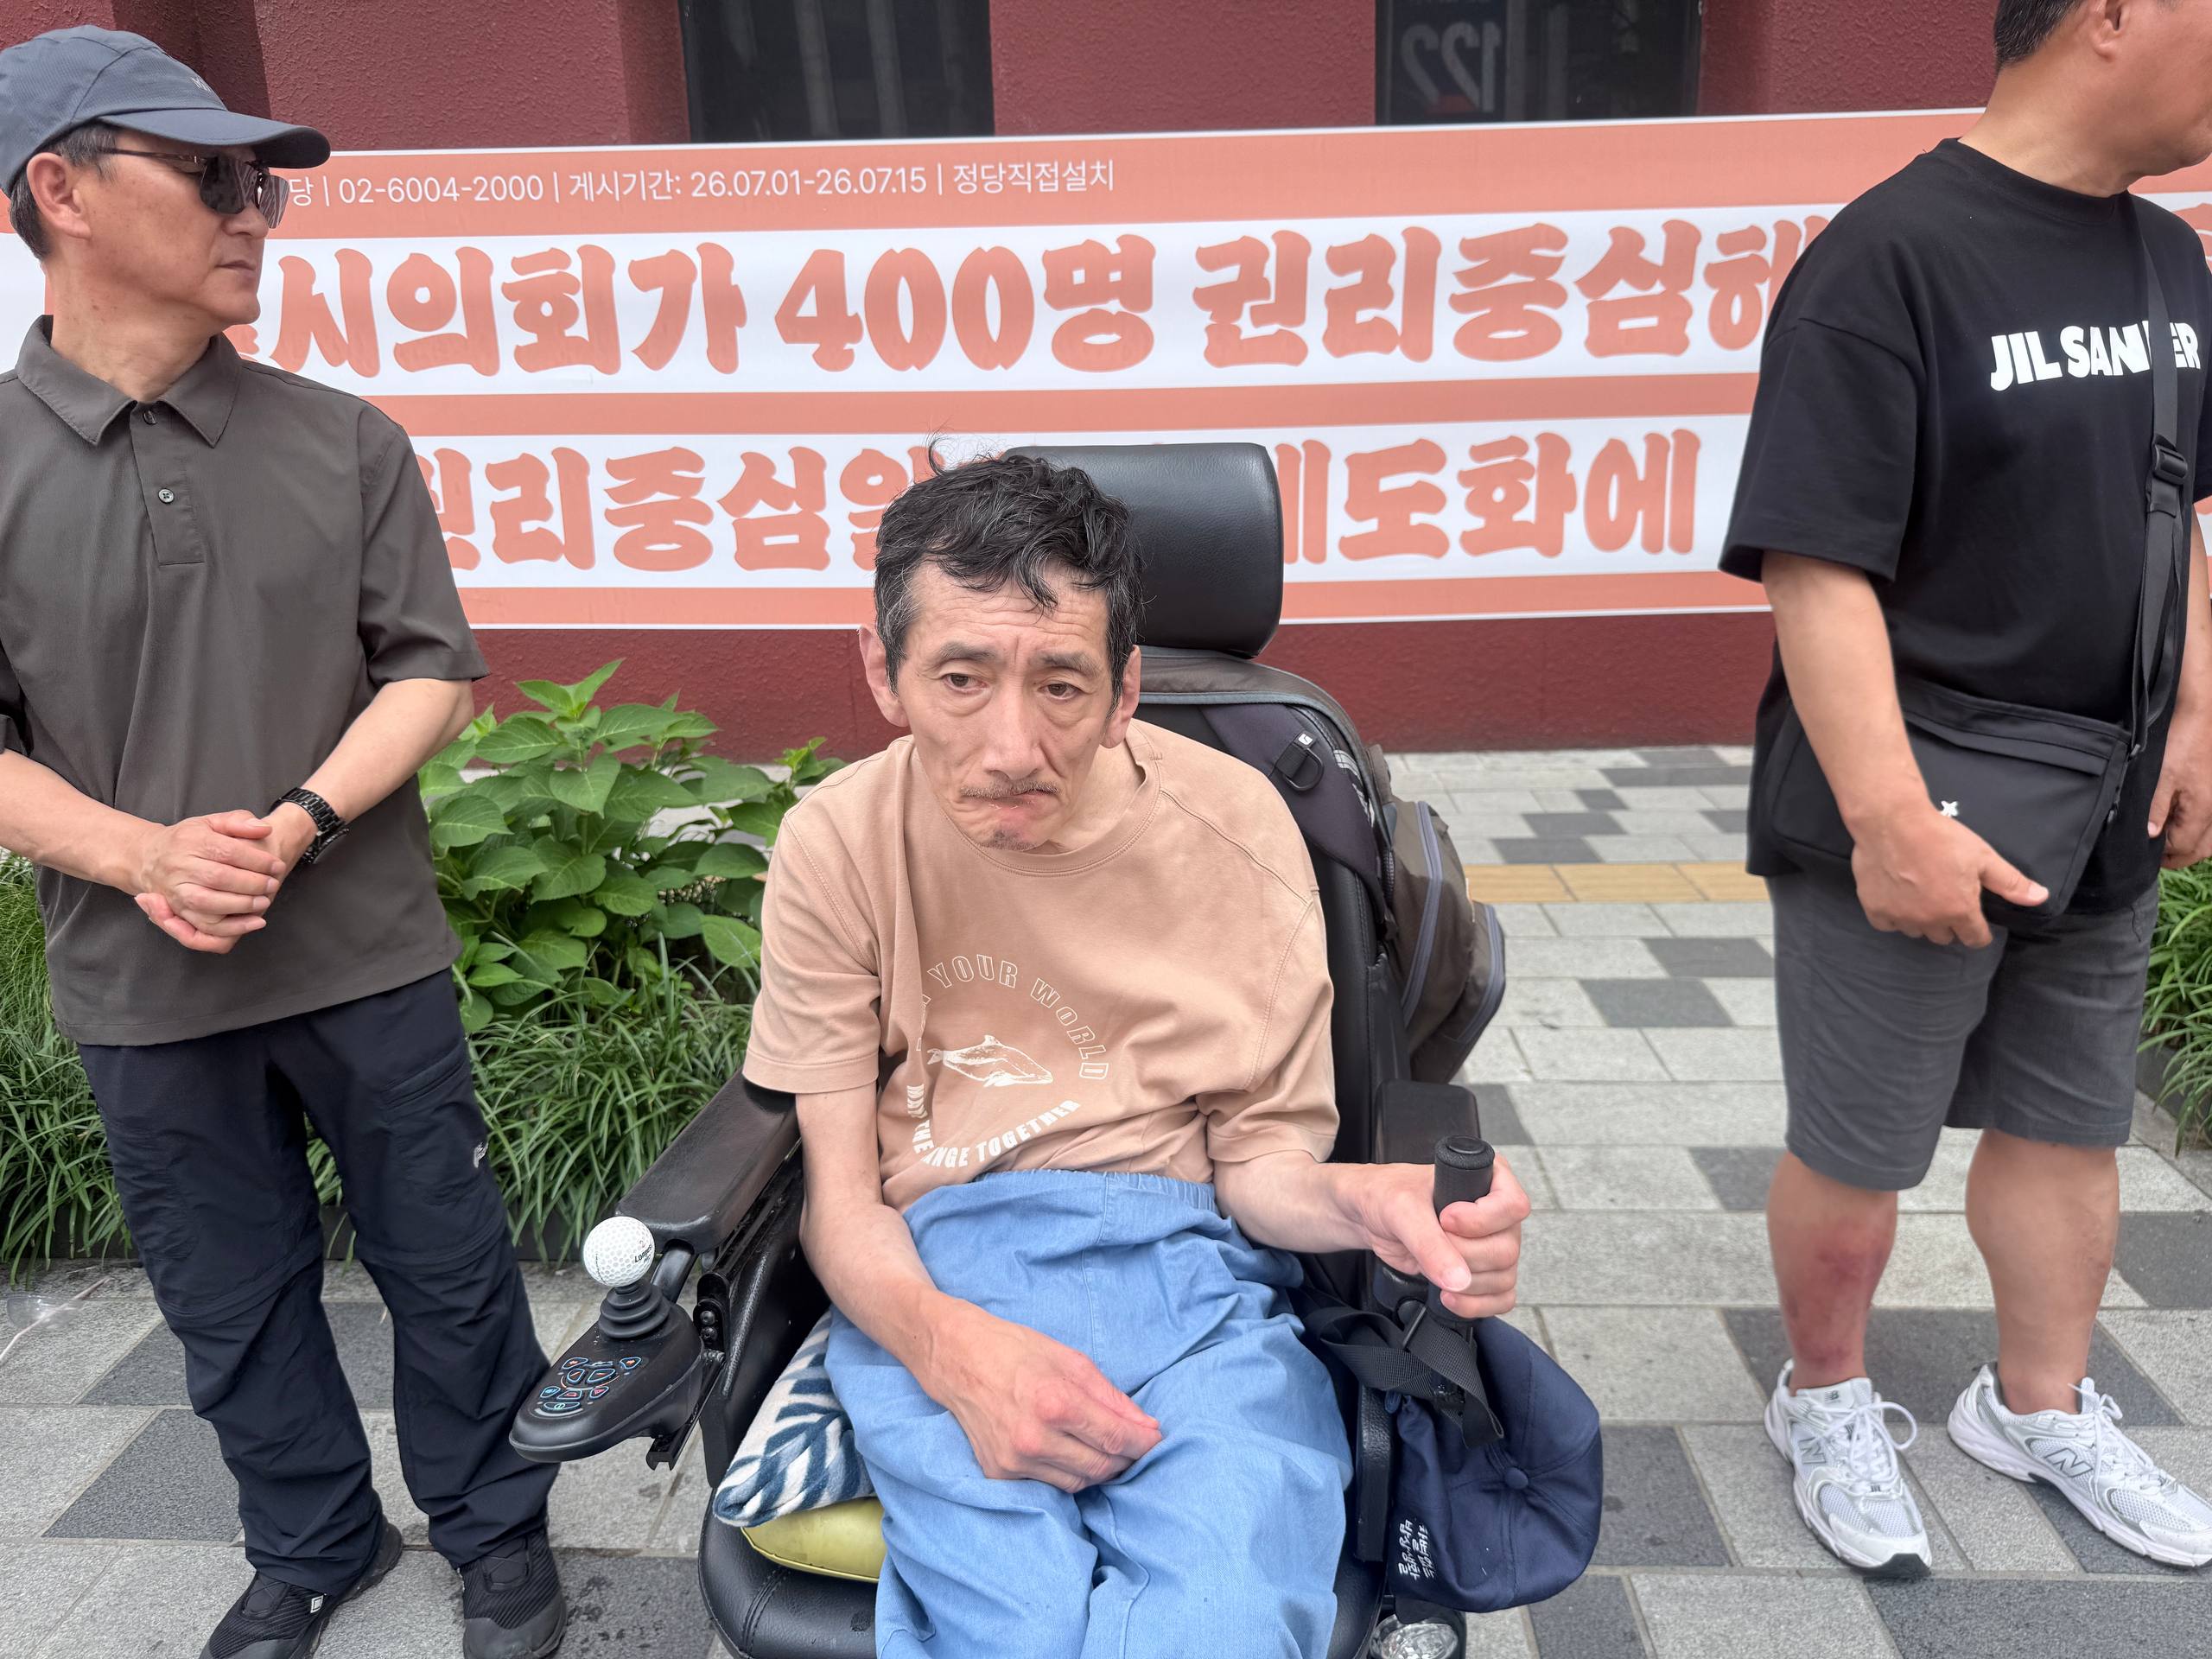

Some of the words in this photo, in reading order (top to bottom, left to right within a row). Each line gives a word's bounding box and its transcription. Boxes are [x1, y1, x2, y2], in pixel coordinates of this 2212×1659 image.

[339, 175, 544, 204] 02-6004-2000
[569, 169, 682, 202] 게시기간:
[690, 164, 928, 199] 26.07.01-26.07.15
[952, 159, 1115, 195] 정당직접설치
[223, 242, 748, 378] 시의회가
[774, 234, 1157, 373] 400명
[1990, 331, 2063, 391] JIL
[2060, 320, 2202, 378] SANER
[927, 954, 1018, 988] YOUR
[1030, 978, 1109, 1080] WORLD
[976, 1099, 1081, 1161] TOGETHER
